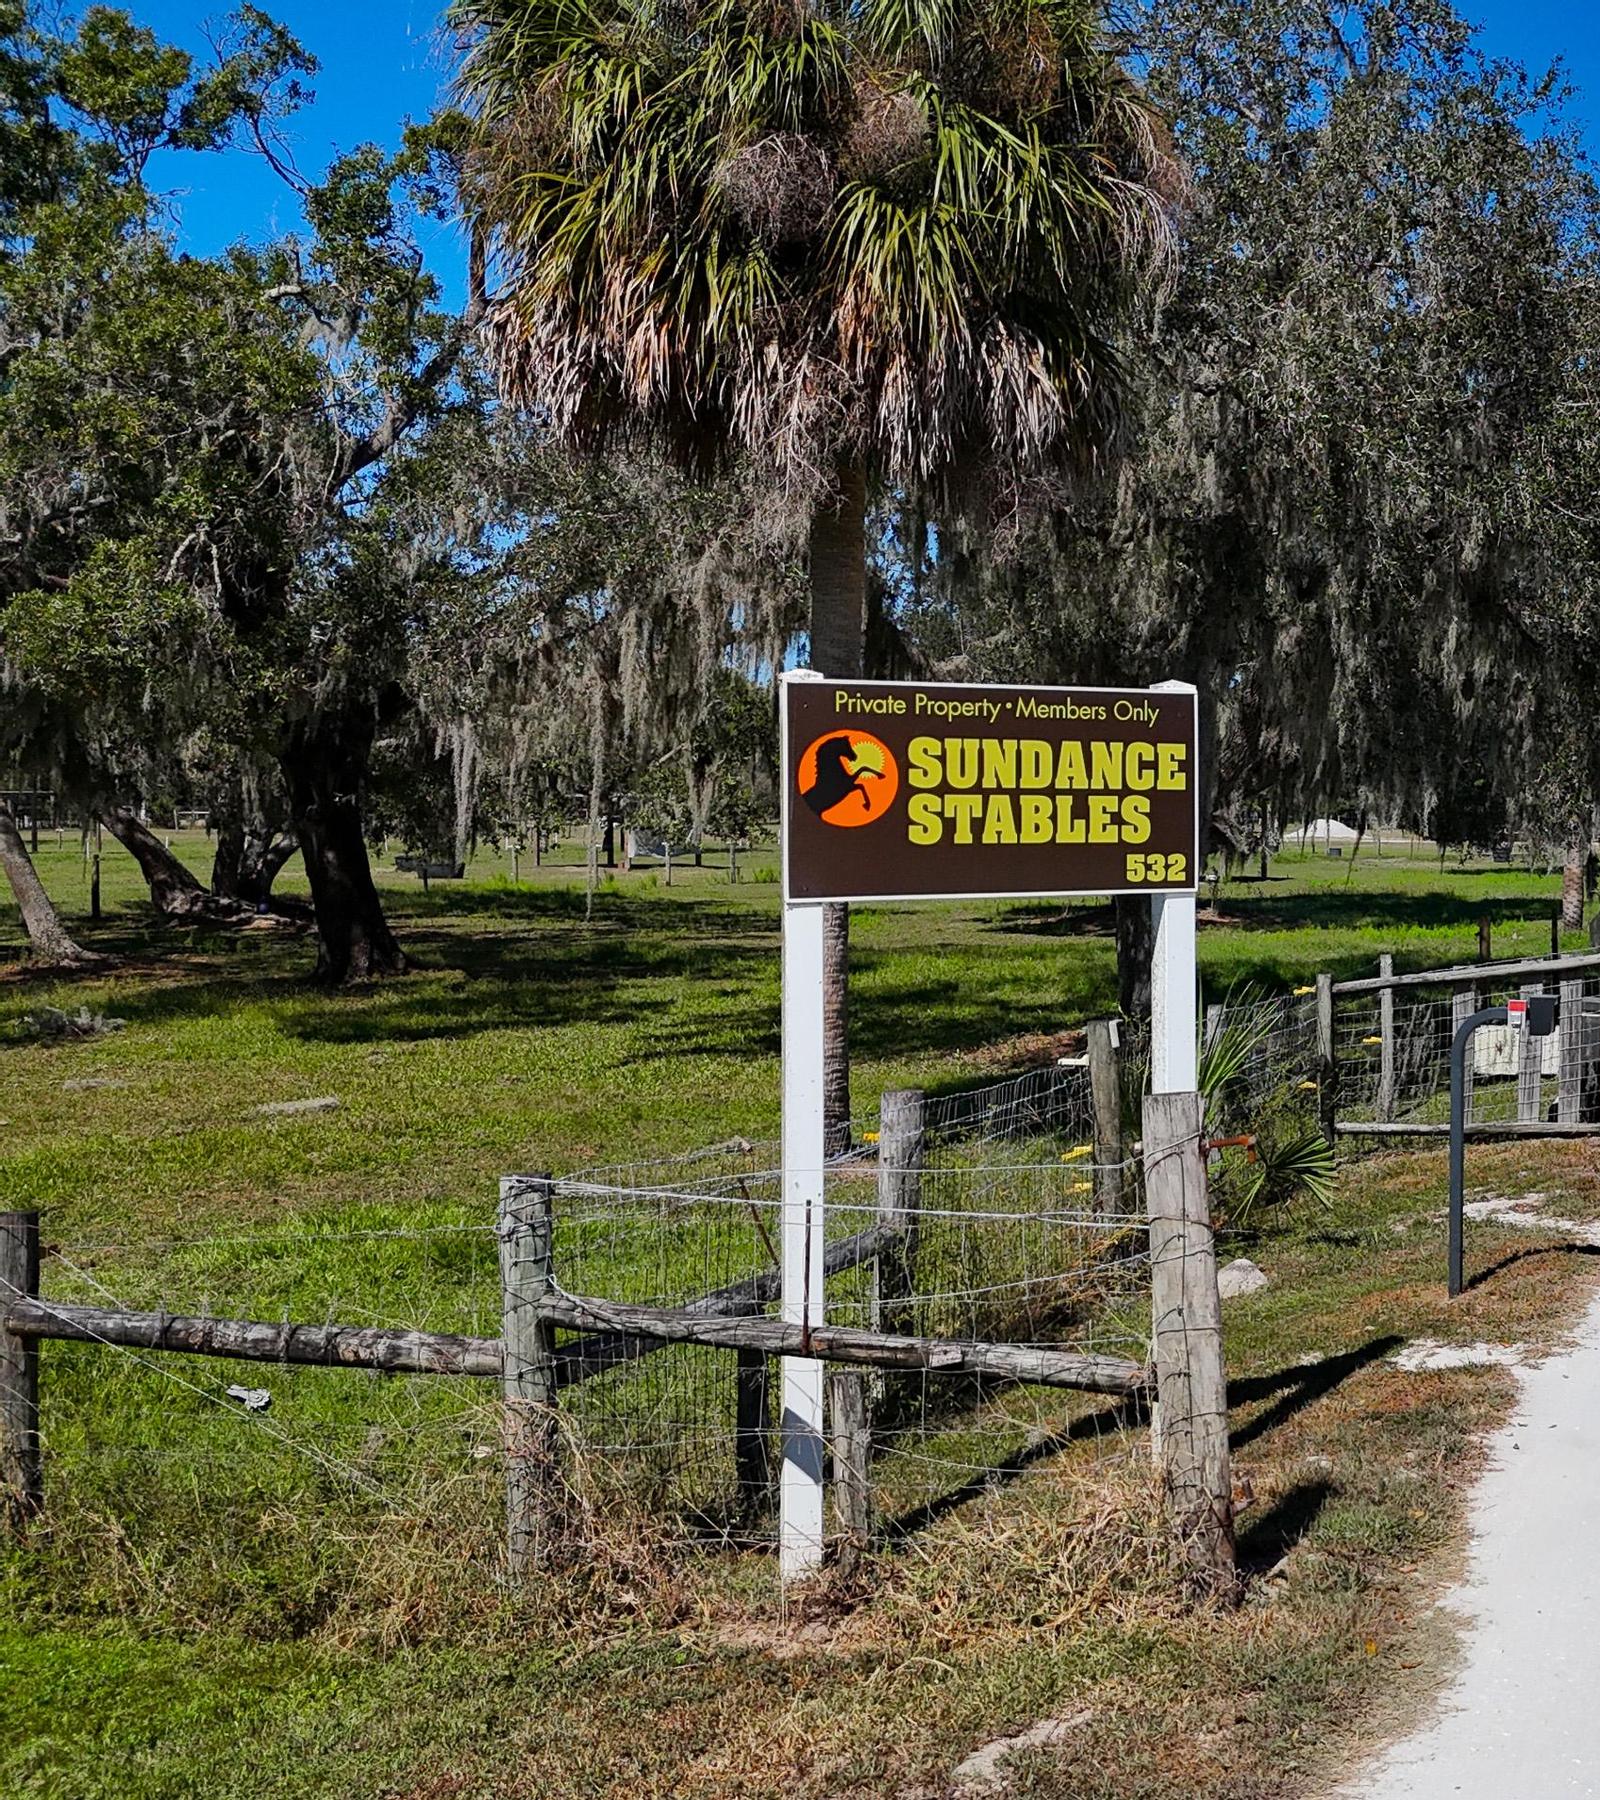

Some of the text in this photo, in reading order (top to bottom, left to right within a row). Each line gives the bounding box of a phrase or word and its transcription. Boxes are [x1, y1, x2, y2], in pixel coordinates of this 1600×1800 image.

[835, 690, 1160, 728] Private Property Members Only
[907, 736, 1187, 791] SUNDANCE
[907, 792, 1152, 845] STABLES
[1126, 853, 1187, 882] 532
